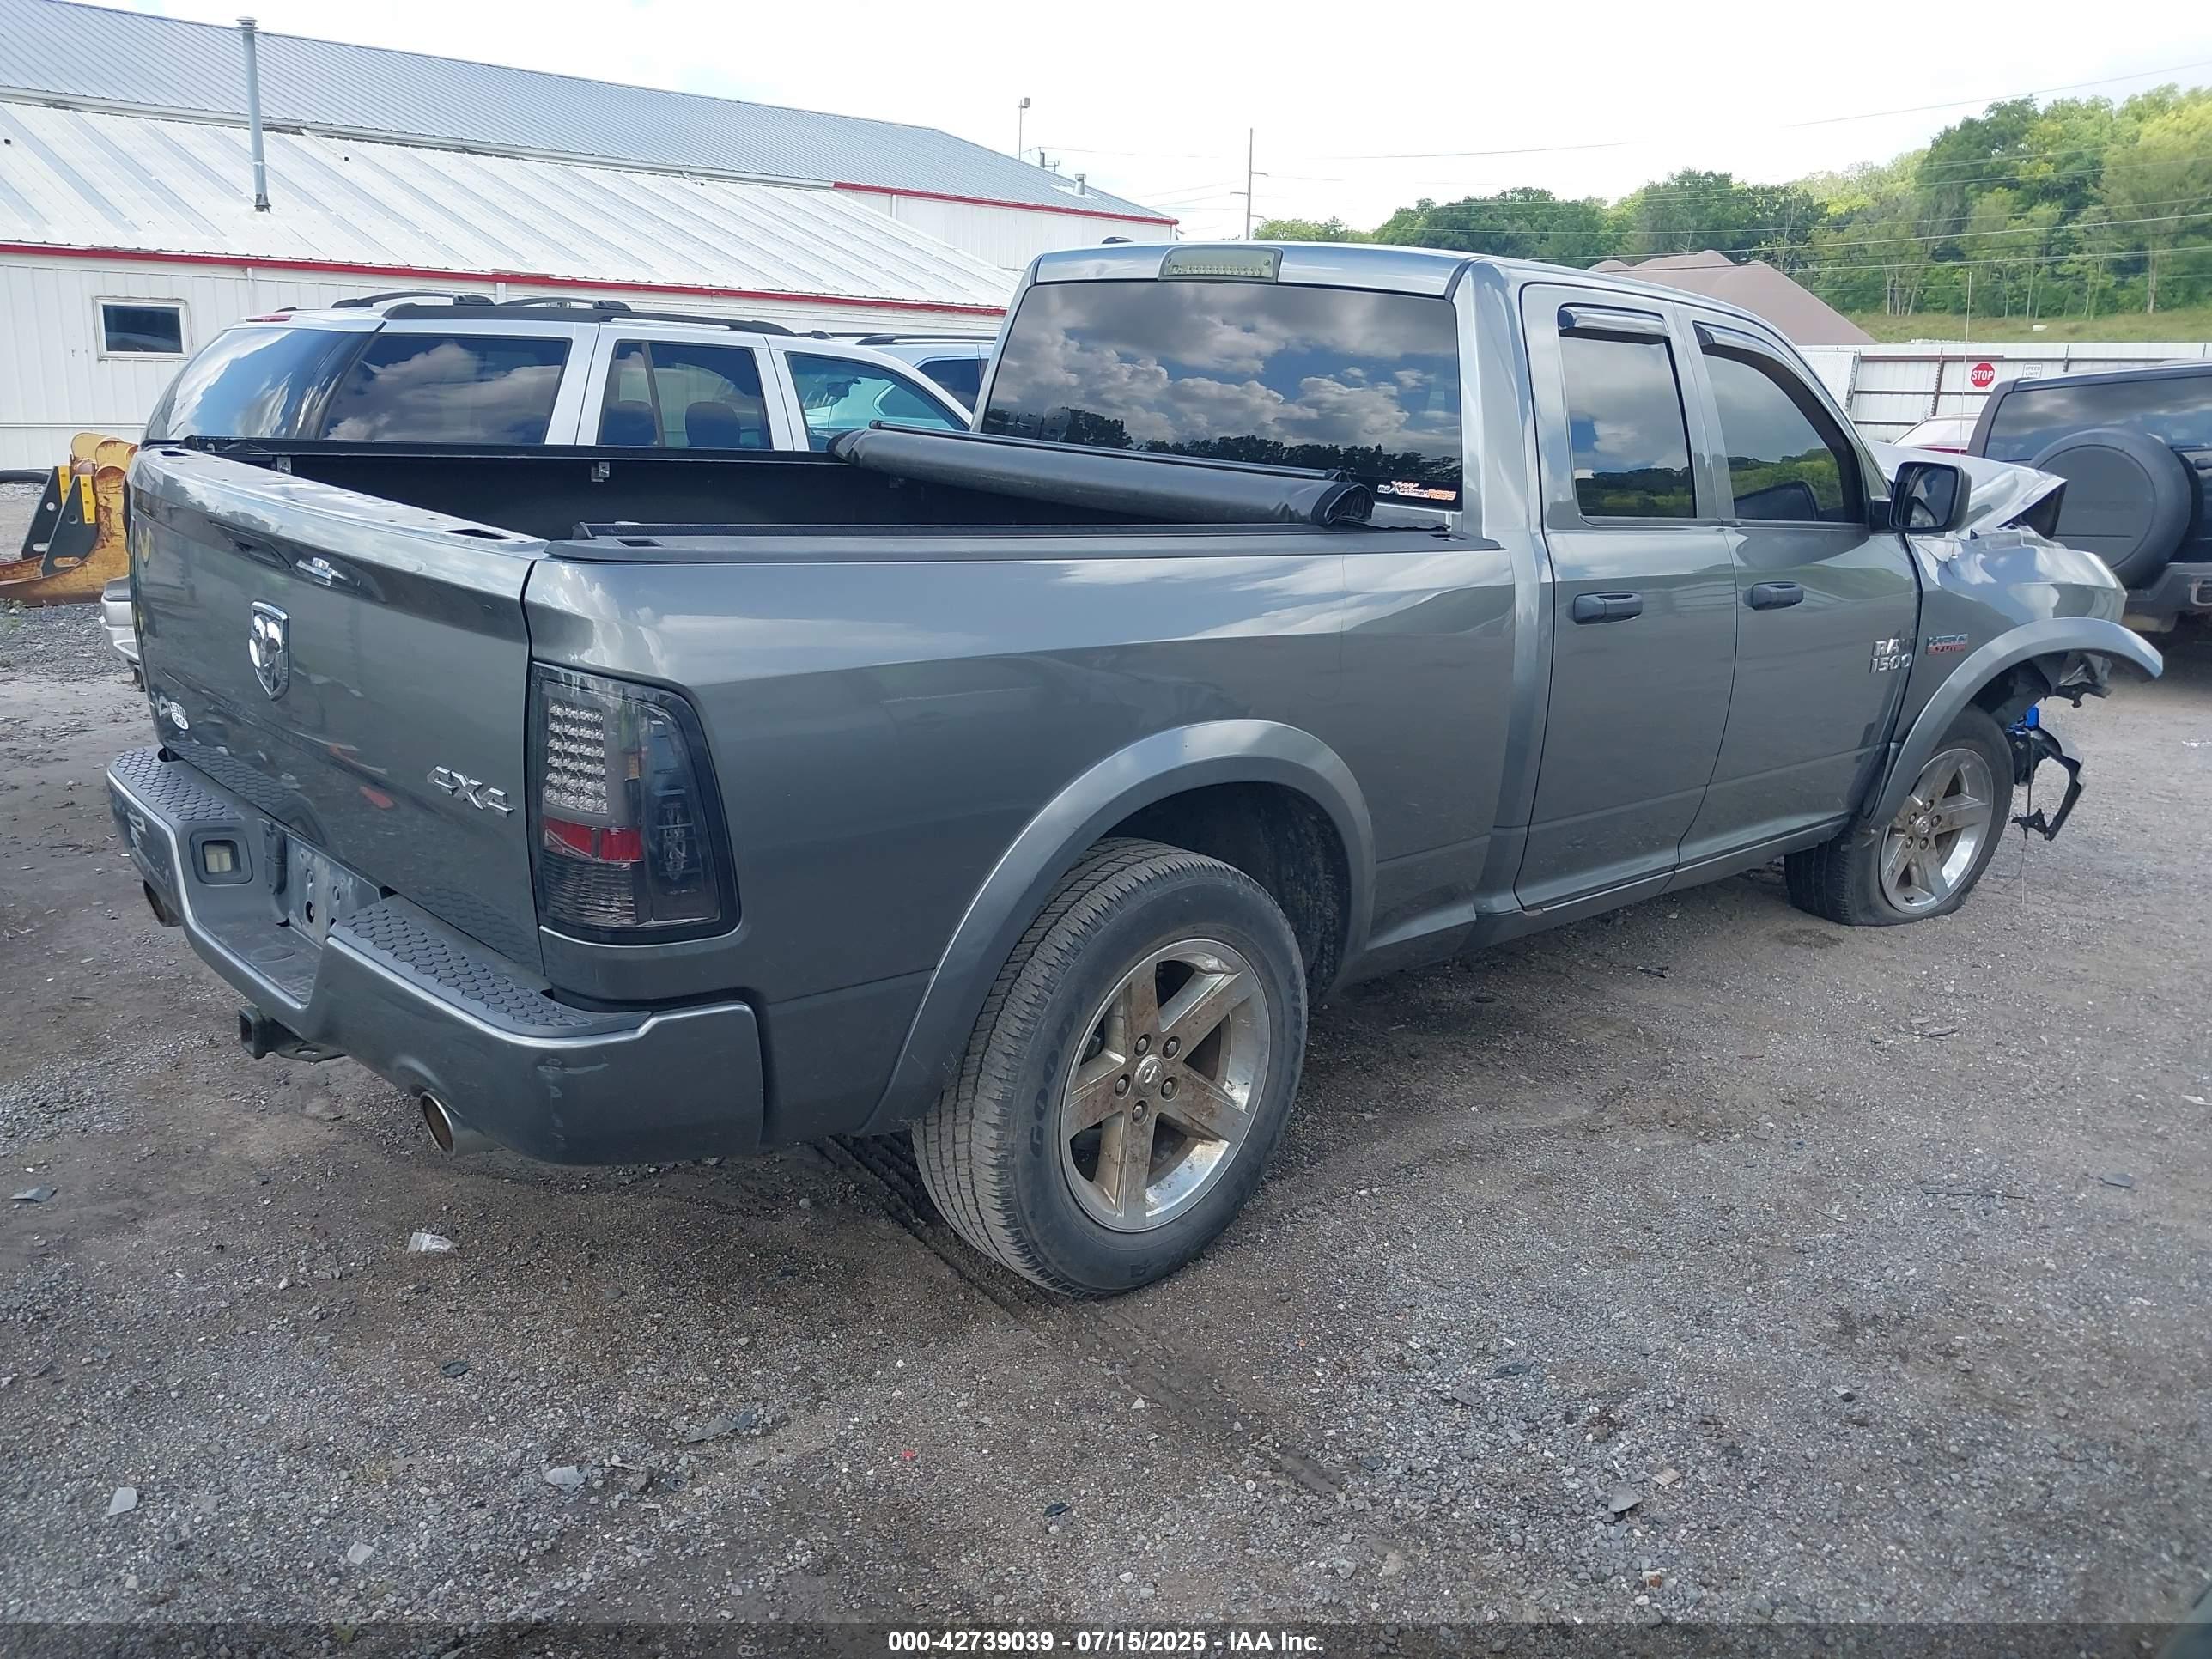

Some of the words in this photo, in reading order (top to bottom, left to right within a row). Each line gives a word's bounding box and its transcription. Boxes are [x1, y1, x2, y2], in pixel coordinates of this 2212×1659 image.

[1971, 370, 1994, 380] STOP
[1870, 653, 1913, 673] 1500
[427, 764, 515, 818] 4X4
